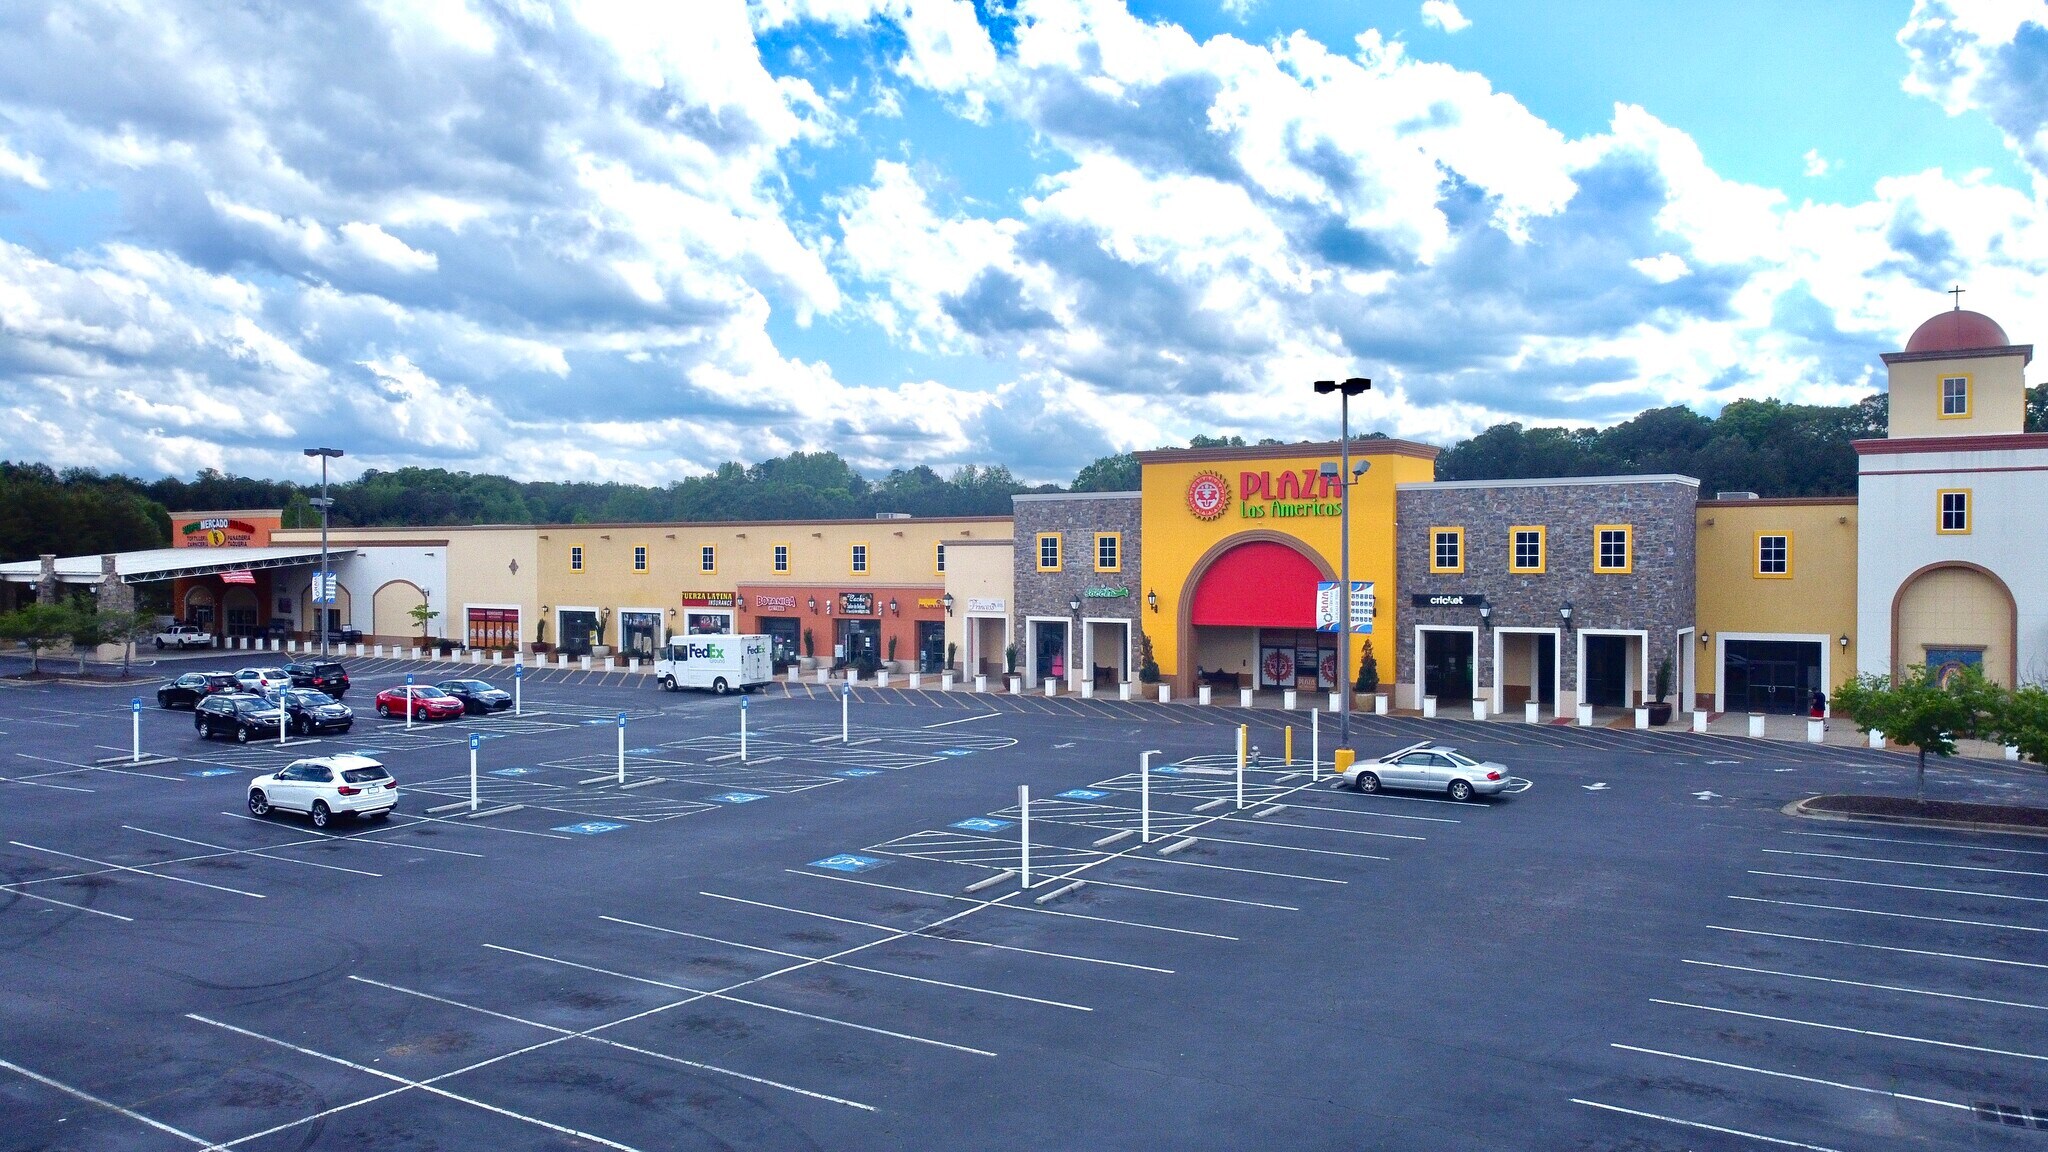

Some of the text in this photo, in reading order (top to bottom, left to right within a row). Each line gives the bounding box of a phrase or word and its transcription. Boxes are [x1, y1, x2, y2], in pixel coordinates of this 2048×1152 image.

[1240, 469, 1342, 500] PLAZA
[1270, 498, 1342, 518] Americas
[200, 519, 228, 530] MERCADO
[707, 592, 732, 600] LATINA
[757, 596, 796, 607] BOTANICA
[1430, 595, 1464, 605] cricket
[1321, 591, 1329, 613] PLAZA
[689, 644, 724, 658] FedEx
[747, 644, 766, 655] FedEx
